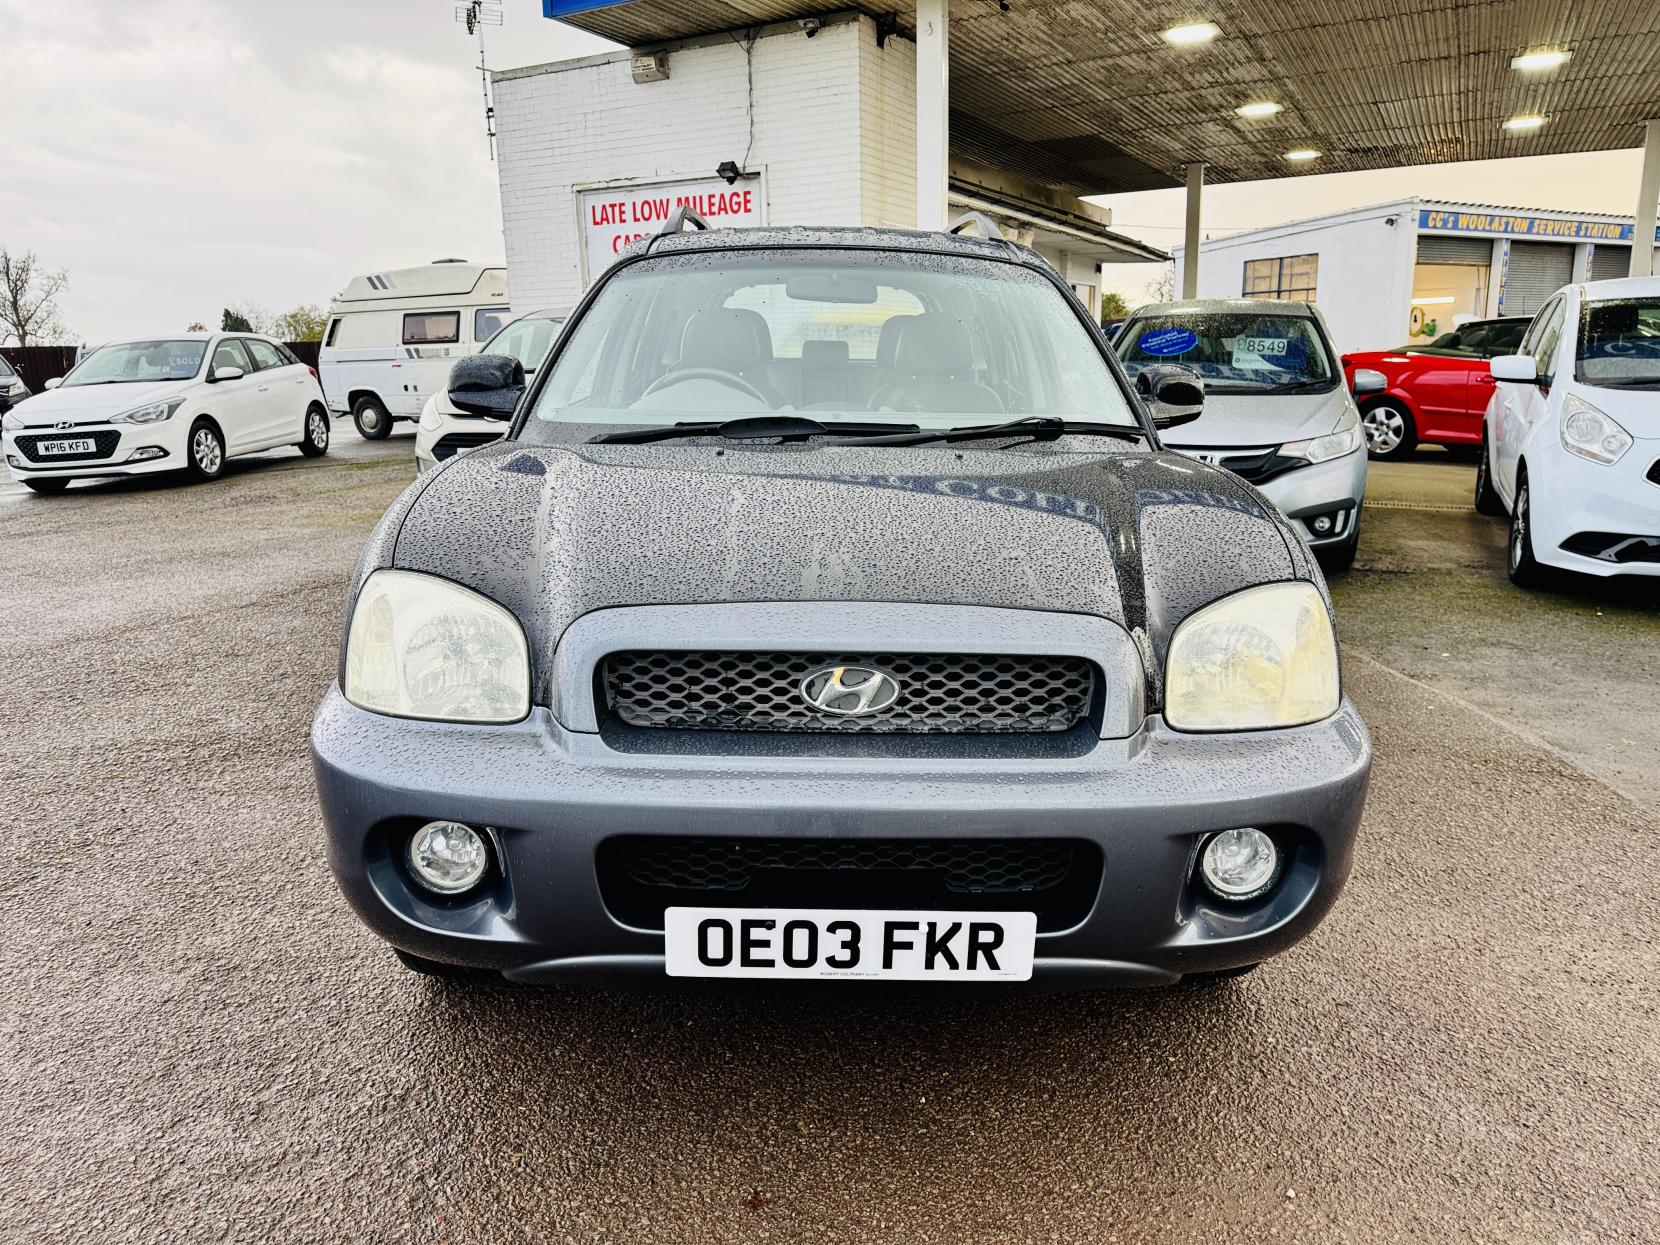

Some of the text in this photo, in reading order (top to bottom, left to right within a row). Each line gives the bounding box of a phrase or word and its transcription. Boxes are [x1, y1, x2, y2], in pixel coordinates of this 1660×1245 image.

[591, 191, 752, 226] LATE LOW MILEAGE
[1458, 214, 1529, 233] WOOLASTON
[1532, 218, 1577, 236] SERVICE
[1579, 222, 1622, 239] STATION
[43, 441, 90, 453] WP16 KFD
[697, 918, 1005, 971] OE03 FKR
